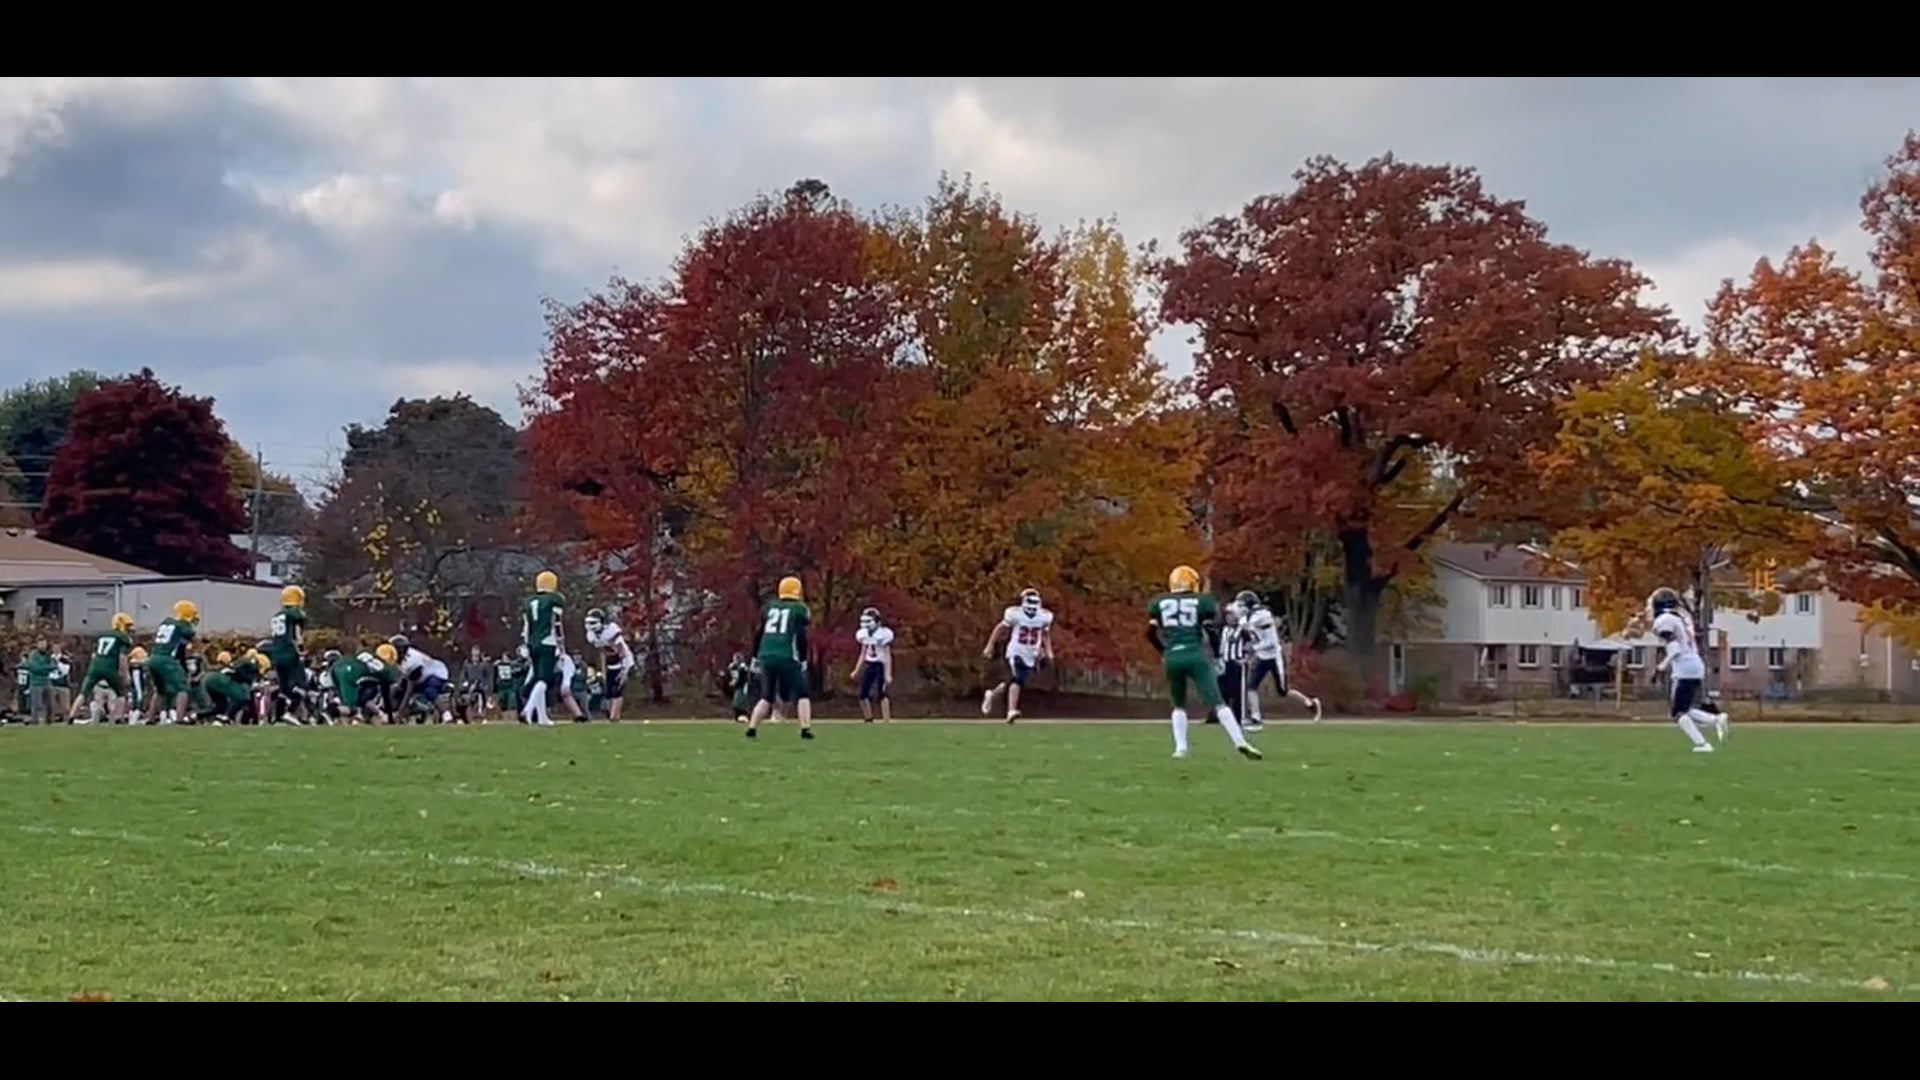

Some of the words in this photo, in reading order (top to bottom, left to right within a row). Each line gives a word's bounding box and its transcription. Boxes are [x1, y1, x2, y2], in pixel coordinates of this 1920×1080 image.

[530, 599, 539, 621] 1
[765, 608, 791, 634] 21
[1158, 598, 1198, 627] 25
[97, 636, 117, 656] 17
